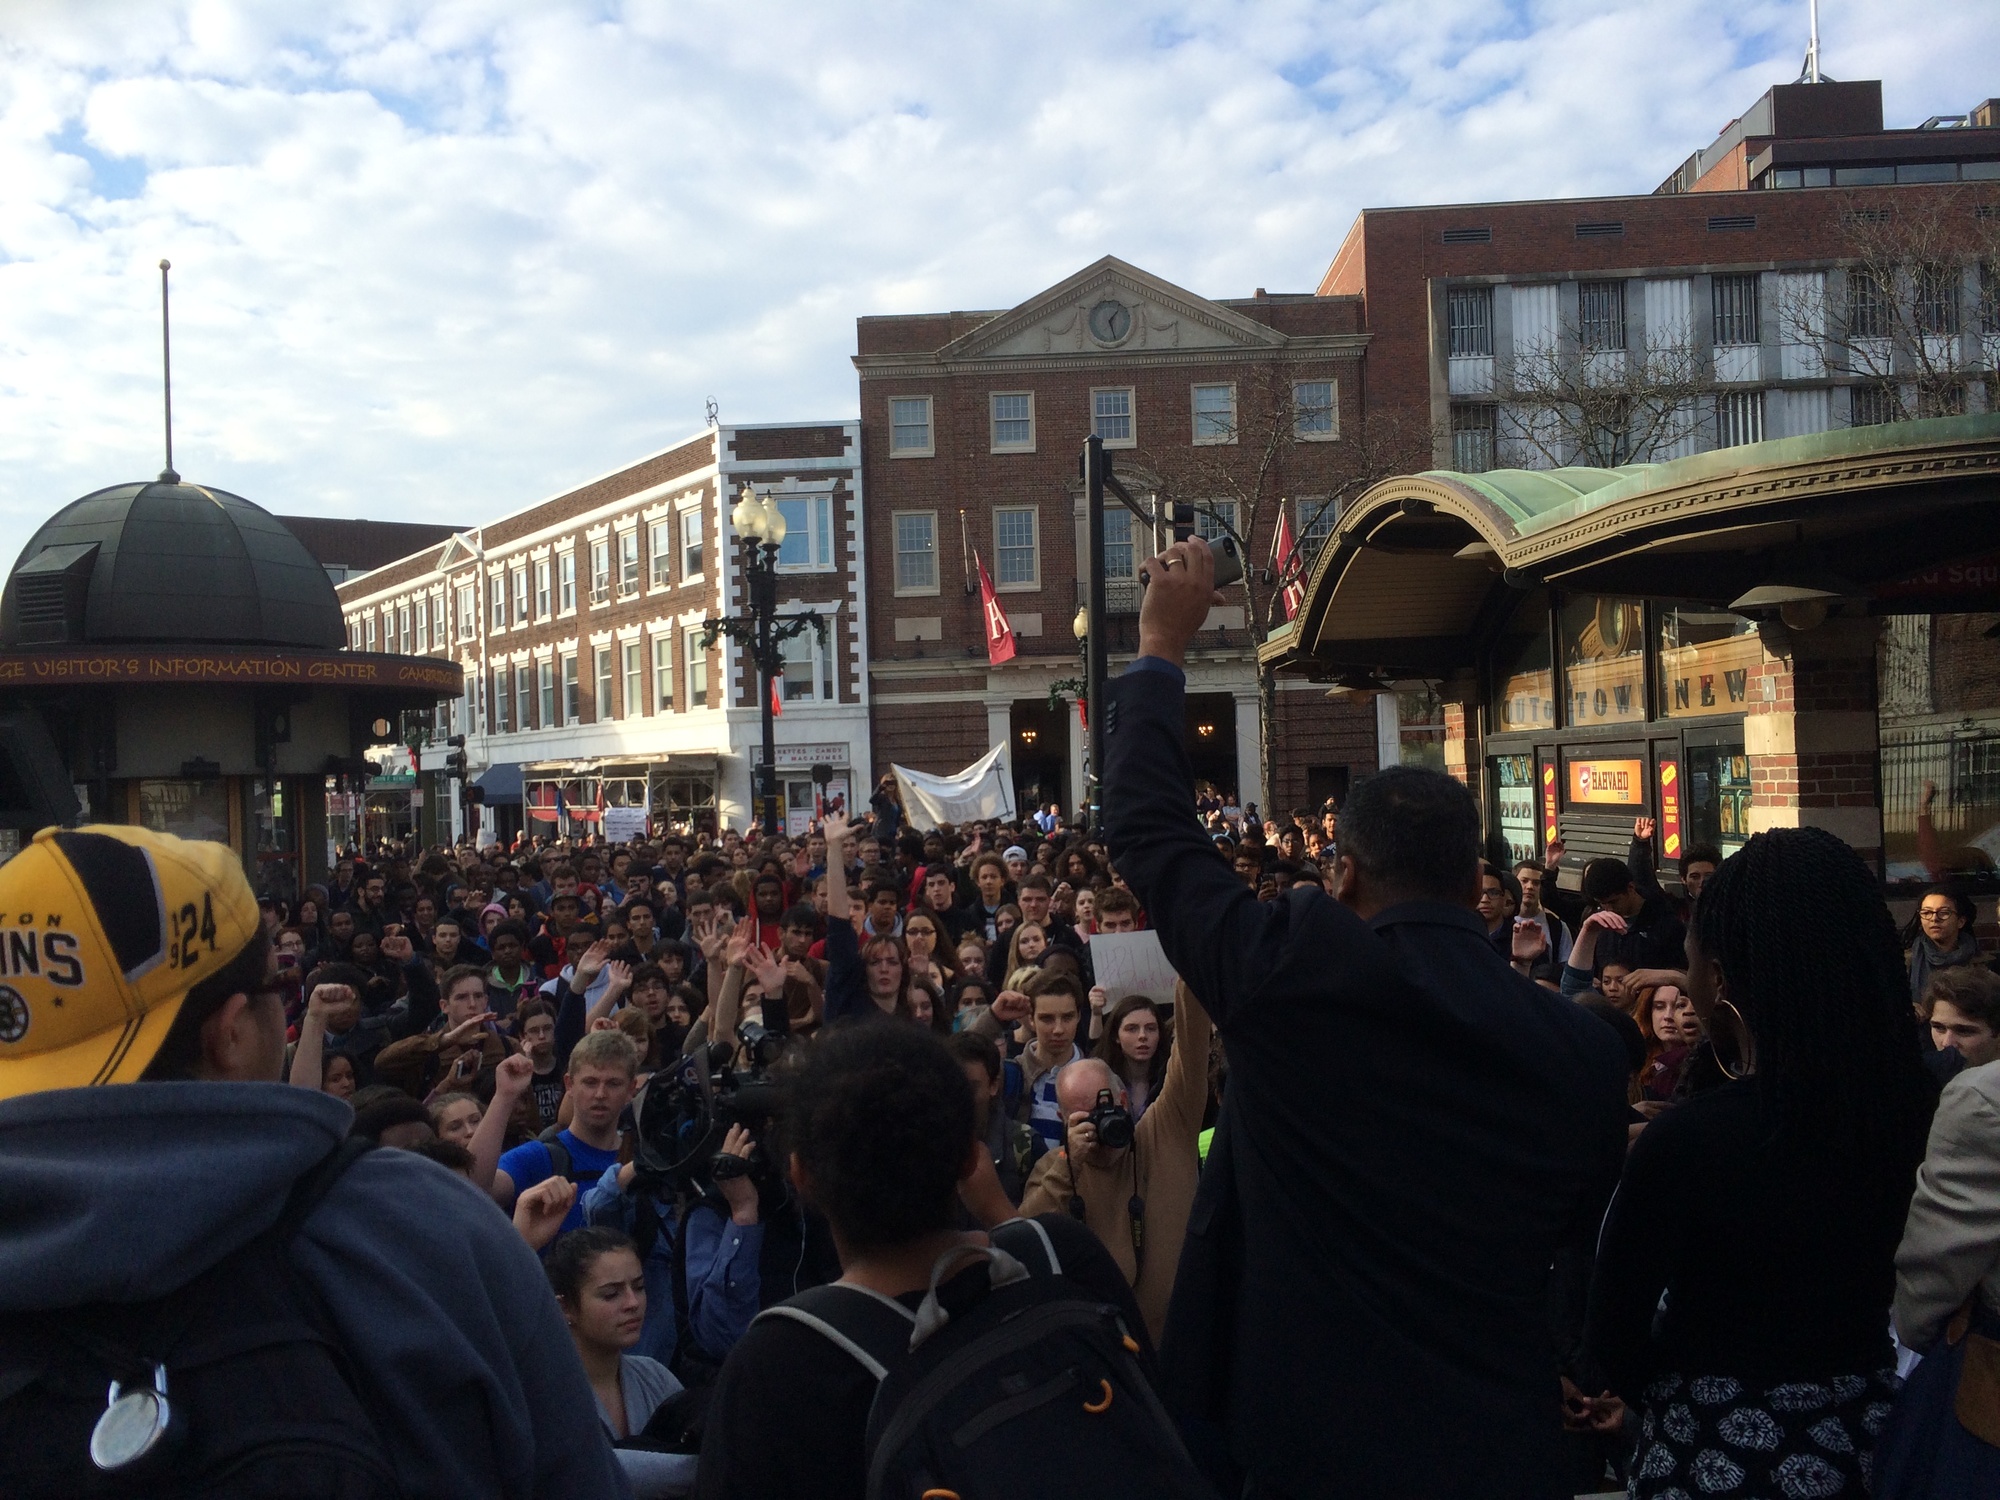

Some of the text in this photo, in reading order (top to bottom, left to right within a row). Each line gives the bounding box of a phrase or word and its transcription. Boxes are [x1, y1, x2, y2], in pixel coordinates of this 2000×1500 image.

[32, 659, 139, 677] VISITOR'S
[150, 658, 300, 678] INFORMATION
[307, 662, 377, 680] CENTER
[1575, 684, 1643, 718] TOW
[758, 747, 807, 755] CRETTES
